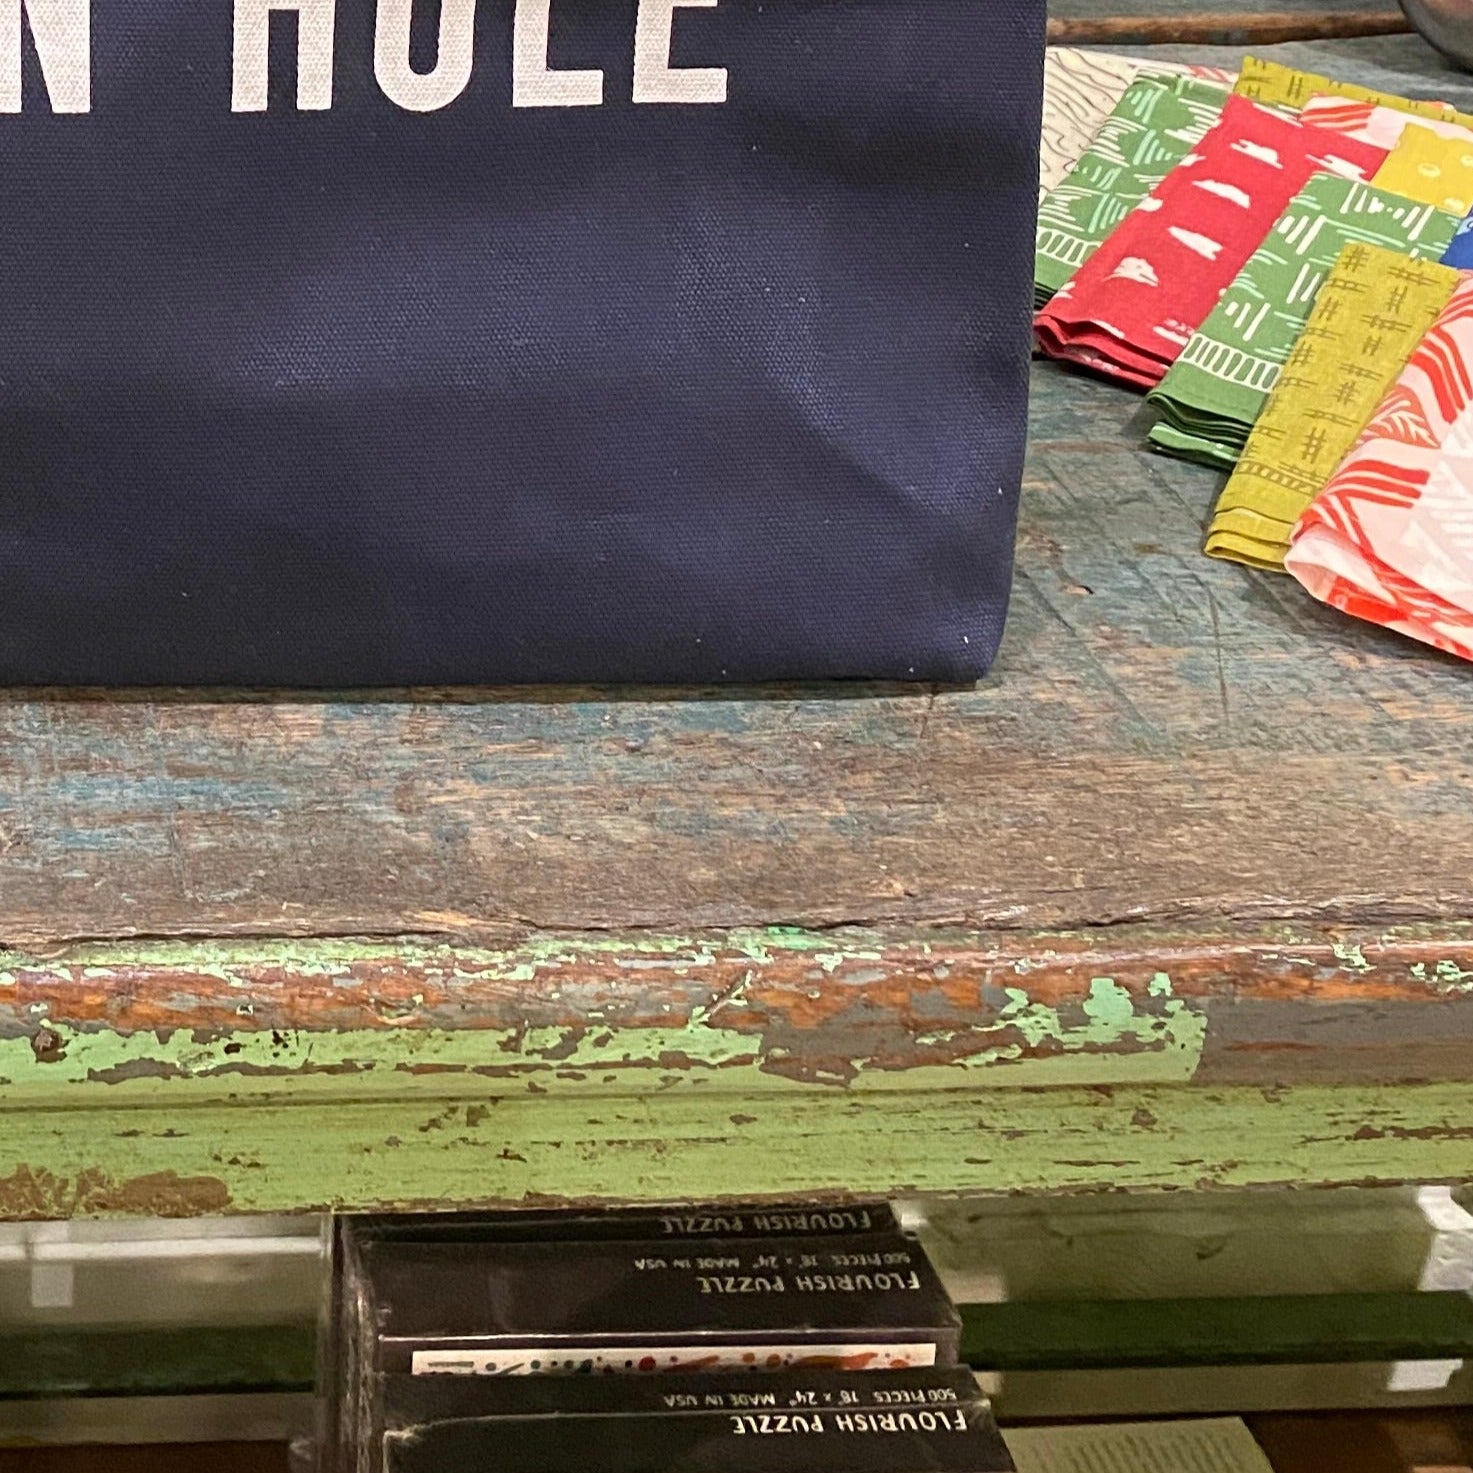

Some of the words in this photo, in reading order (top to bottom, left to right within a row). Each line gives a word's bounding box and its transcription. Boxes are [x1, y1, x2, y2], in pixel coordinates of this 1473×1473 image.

[634, 1258, 667, 1270] USA
[696, 1275, 784, 1293] PUZZLE
[796, 1271, 921, 1291] FLOURISH
[664, 1394, 698, 1407] USA
[704, 1394, 724, 1406] IN
[729, 1392, 776, 1406] MADE
[873, 1390, 924, 1404] PIECES
[927, 1388, 956, 1401] 500
[728, 1412, 824, 1435] PUZZLE
[835, 1408, 967, 1433] FLOURISH
